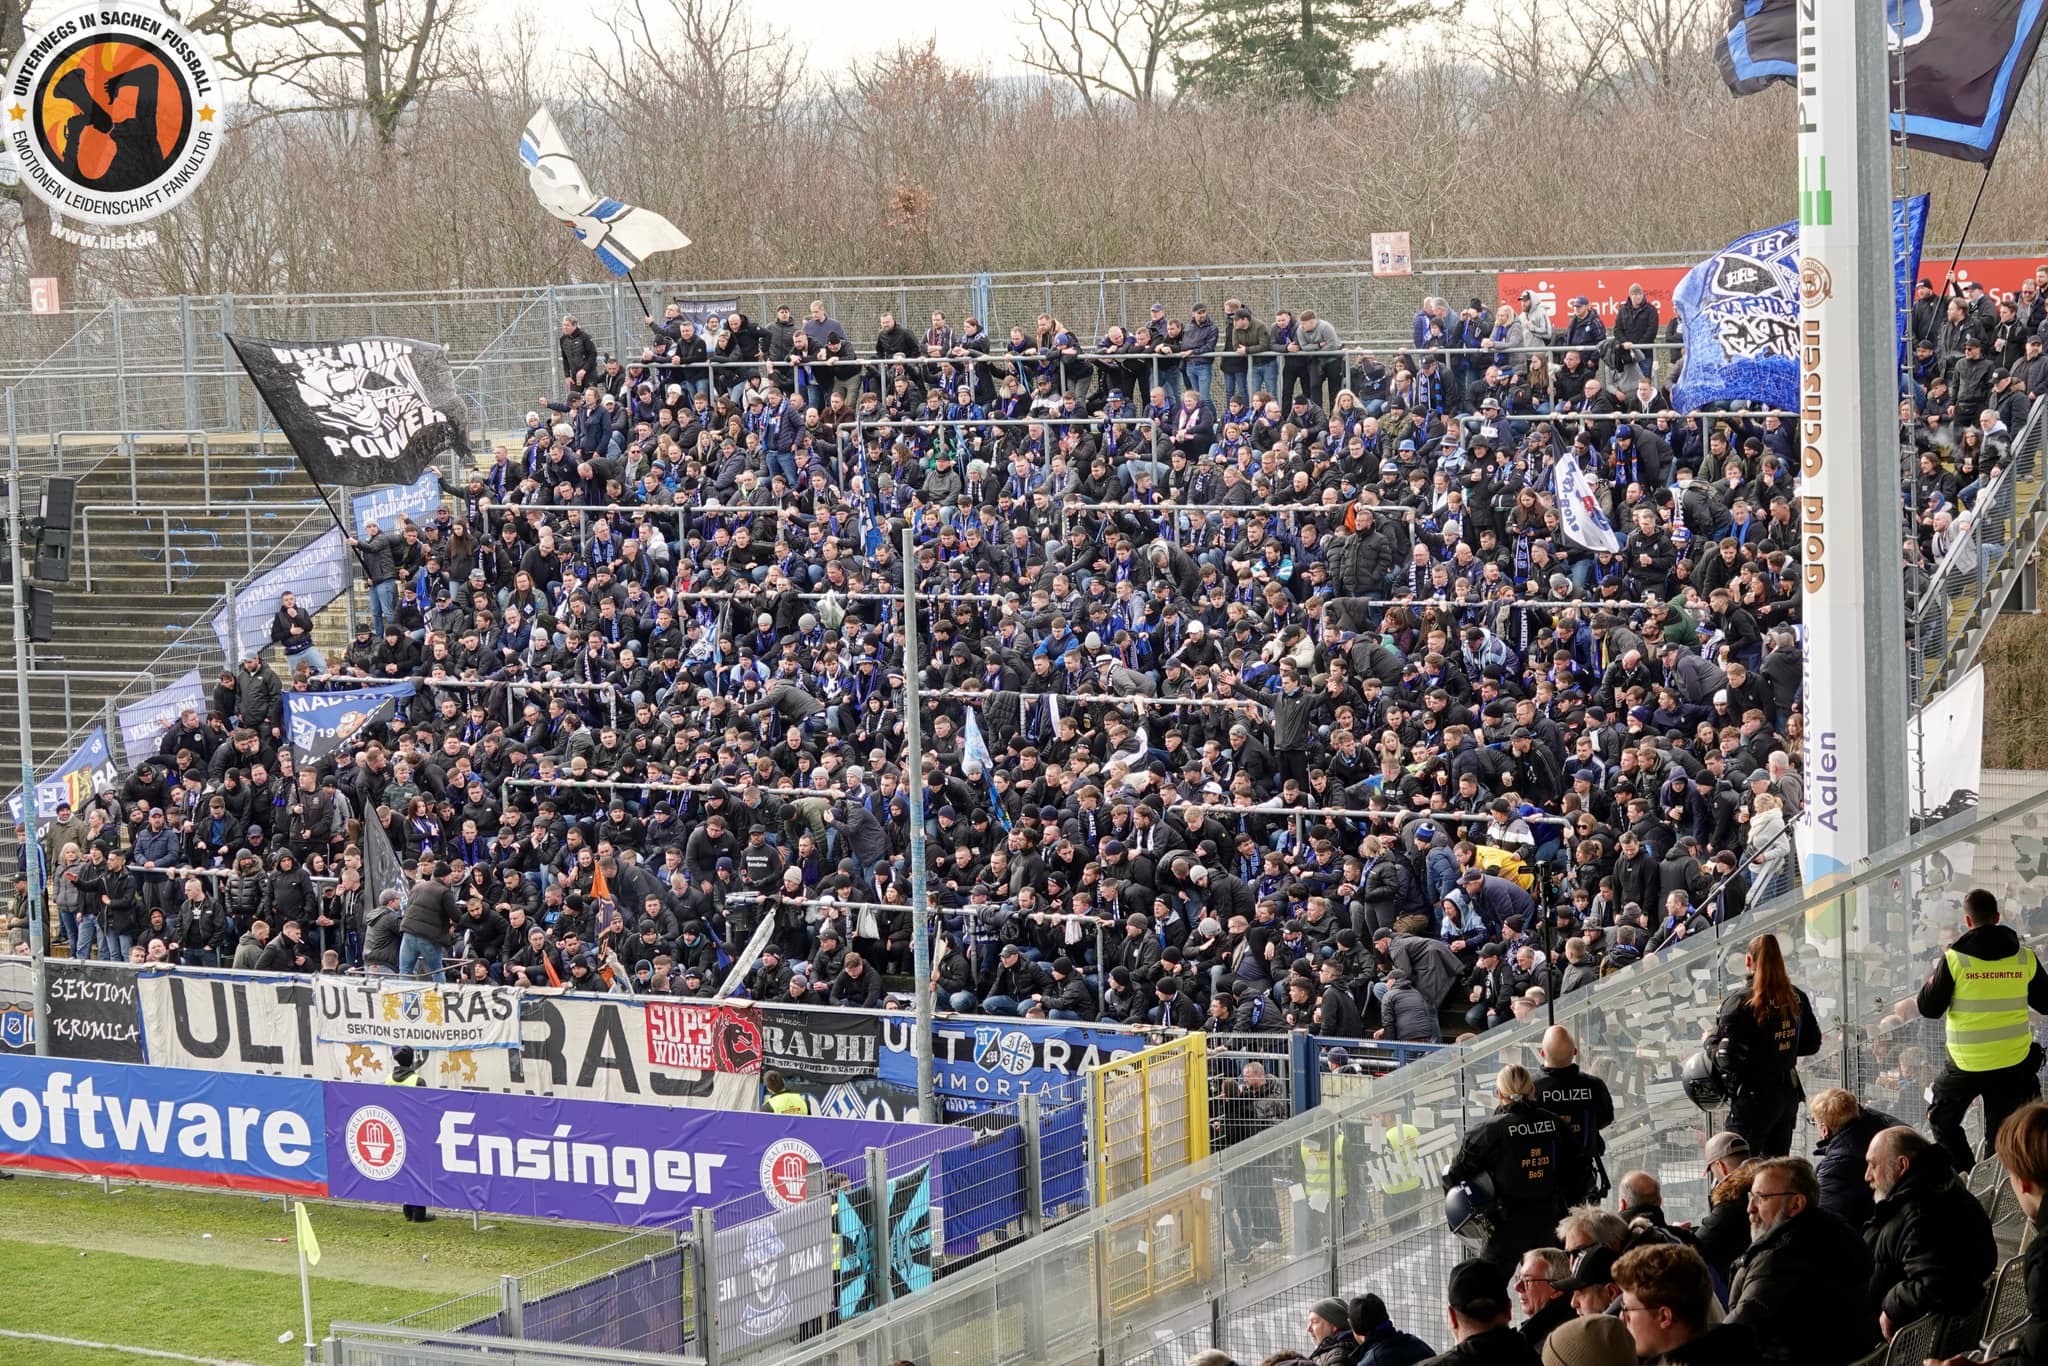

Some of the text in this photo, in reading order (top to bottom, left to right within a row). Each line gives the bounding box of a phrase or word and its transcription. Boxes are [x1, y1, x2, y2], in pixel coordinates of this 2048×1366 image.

[1567, 296, 1662, 317] Sarke
[323, 406, 448, 460] POWER
[1802, 320, 1825, 594] Gold Ochsen
[1816, 731, 1838, 833] Aalen
[51, 977, 135, 1005] SEKTION
[320, 985, 513, 1023] ULT RAS
[53, 1018, 140, 1043] KROMILA
[170, 977, 315, 1066] ULT
[347, 1023, 483, 1042] SEKTION STADIONVERBOT
[650, 1005, 713, 1045] SUPS
[651, 1040, 713, 1069] WORMS
[762, 1025, 877, 1062] RAPHI
[1542, 1088, 1593, 1102] POLIZEI
[0, 1071, 312, 1168] oftware
[1508, 1120, 1557, 1136] POLIZEI
